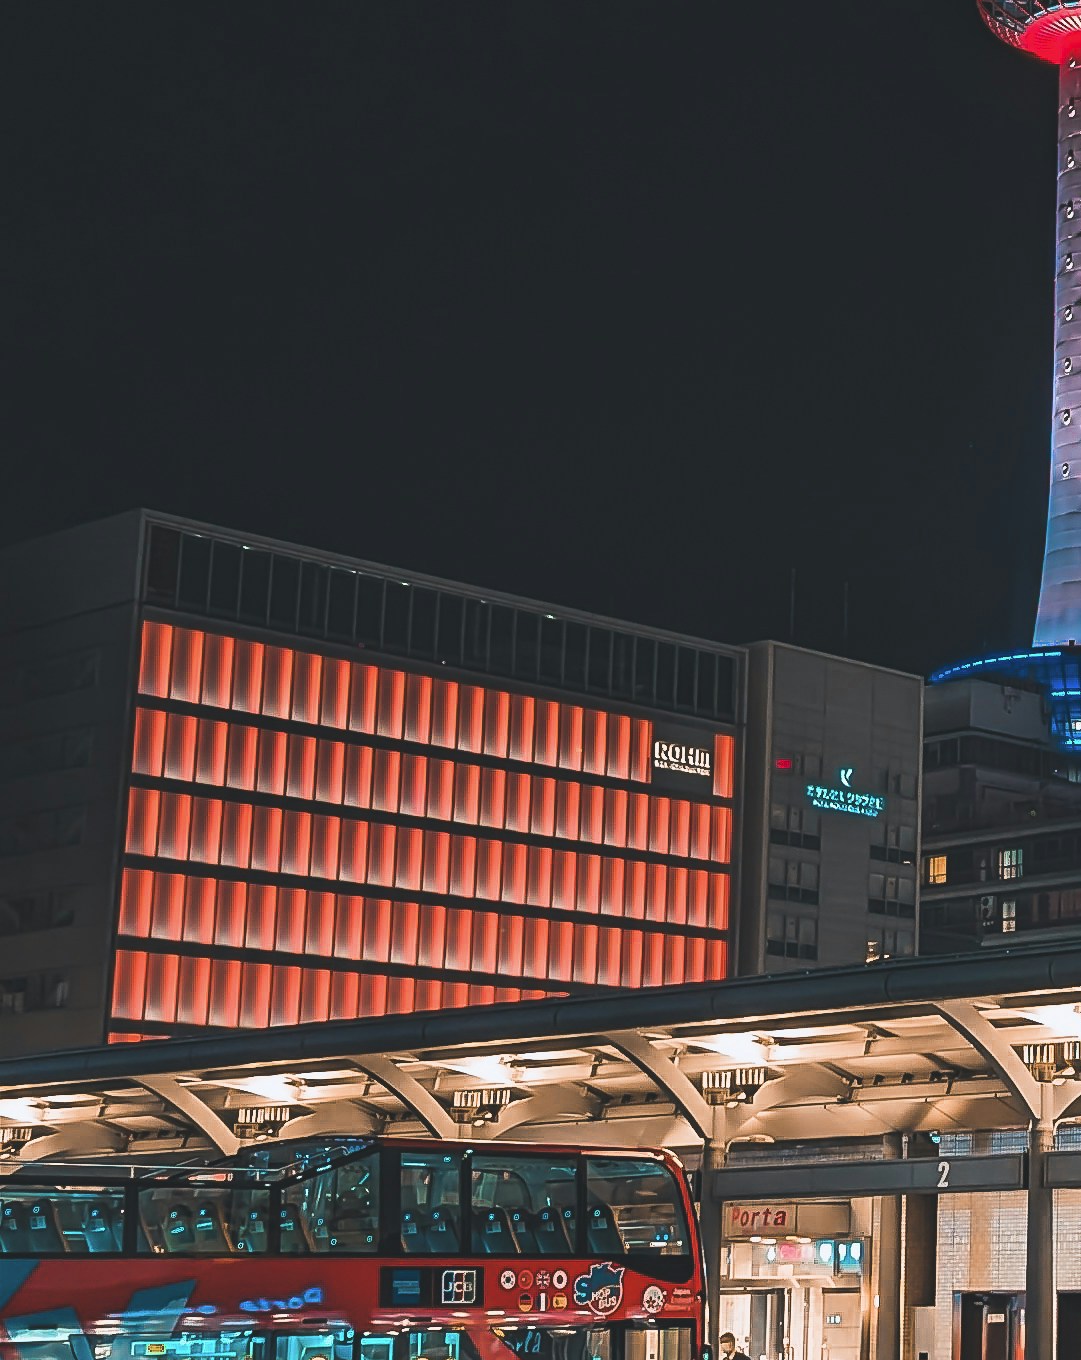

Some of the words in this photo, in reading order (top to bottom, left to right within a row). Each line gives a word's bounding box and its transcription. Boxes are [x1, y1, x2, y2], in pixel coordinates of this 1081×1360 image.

[936, 1161, 950, 1188] 2
[731, 1206, 787, 1227] Porta
[443, 1281, 473, 1293] JCB
